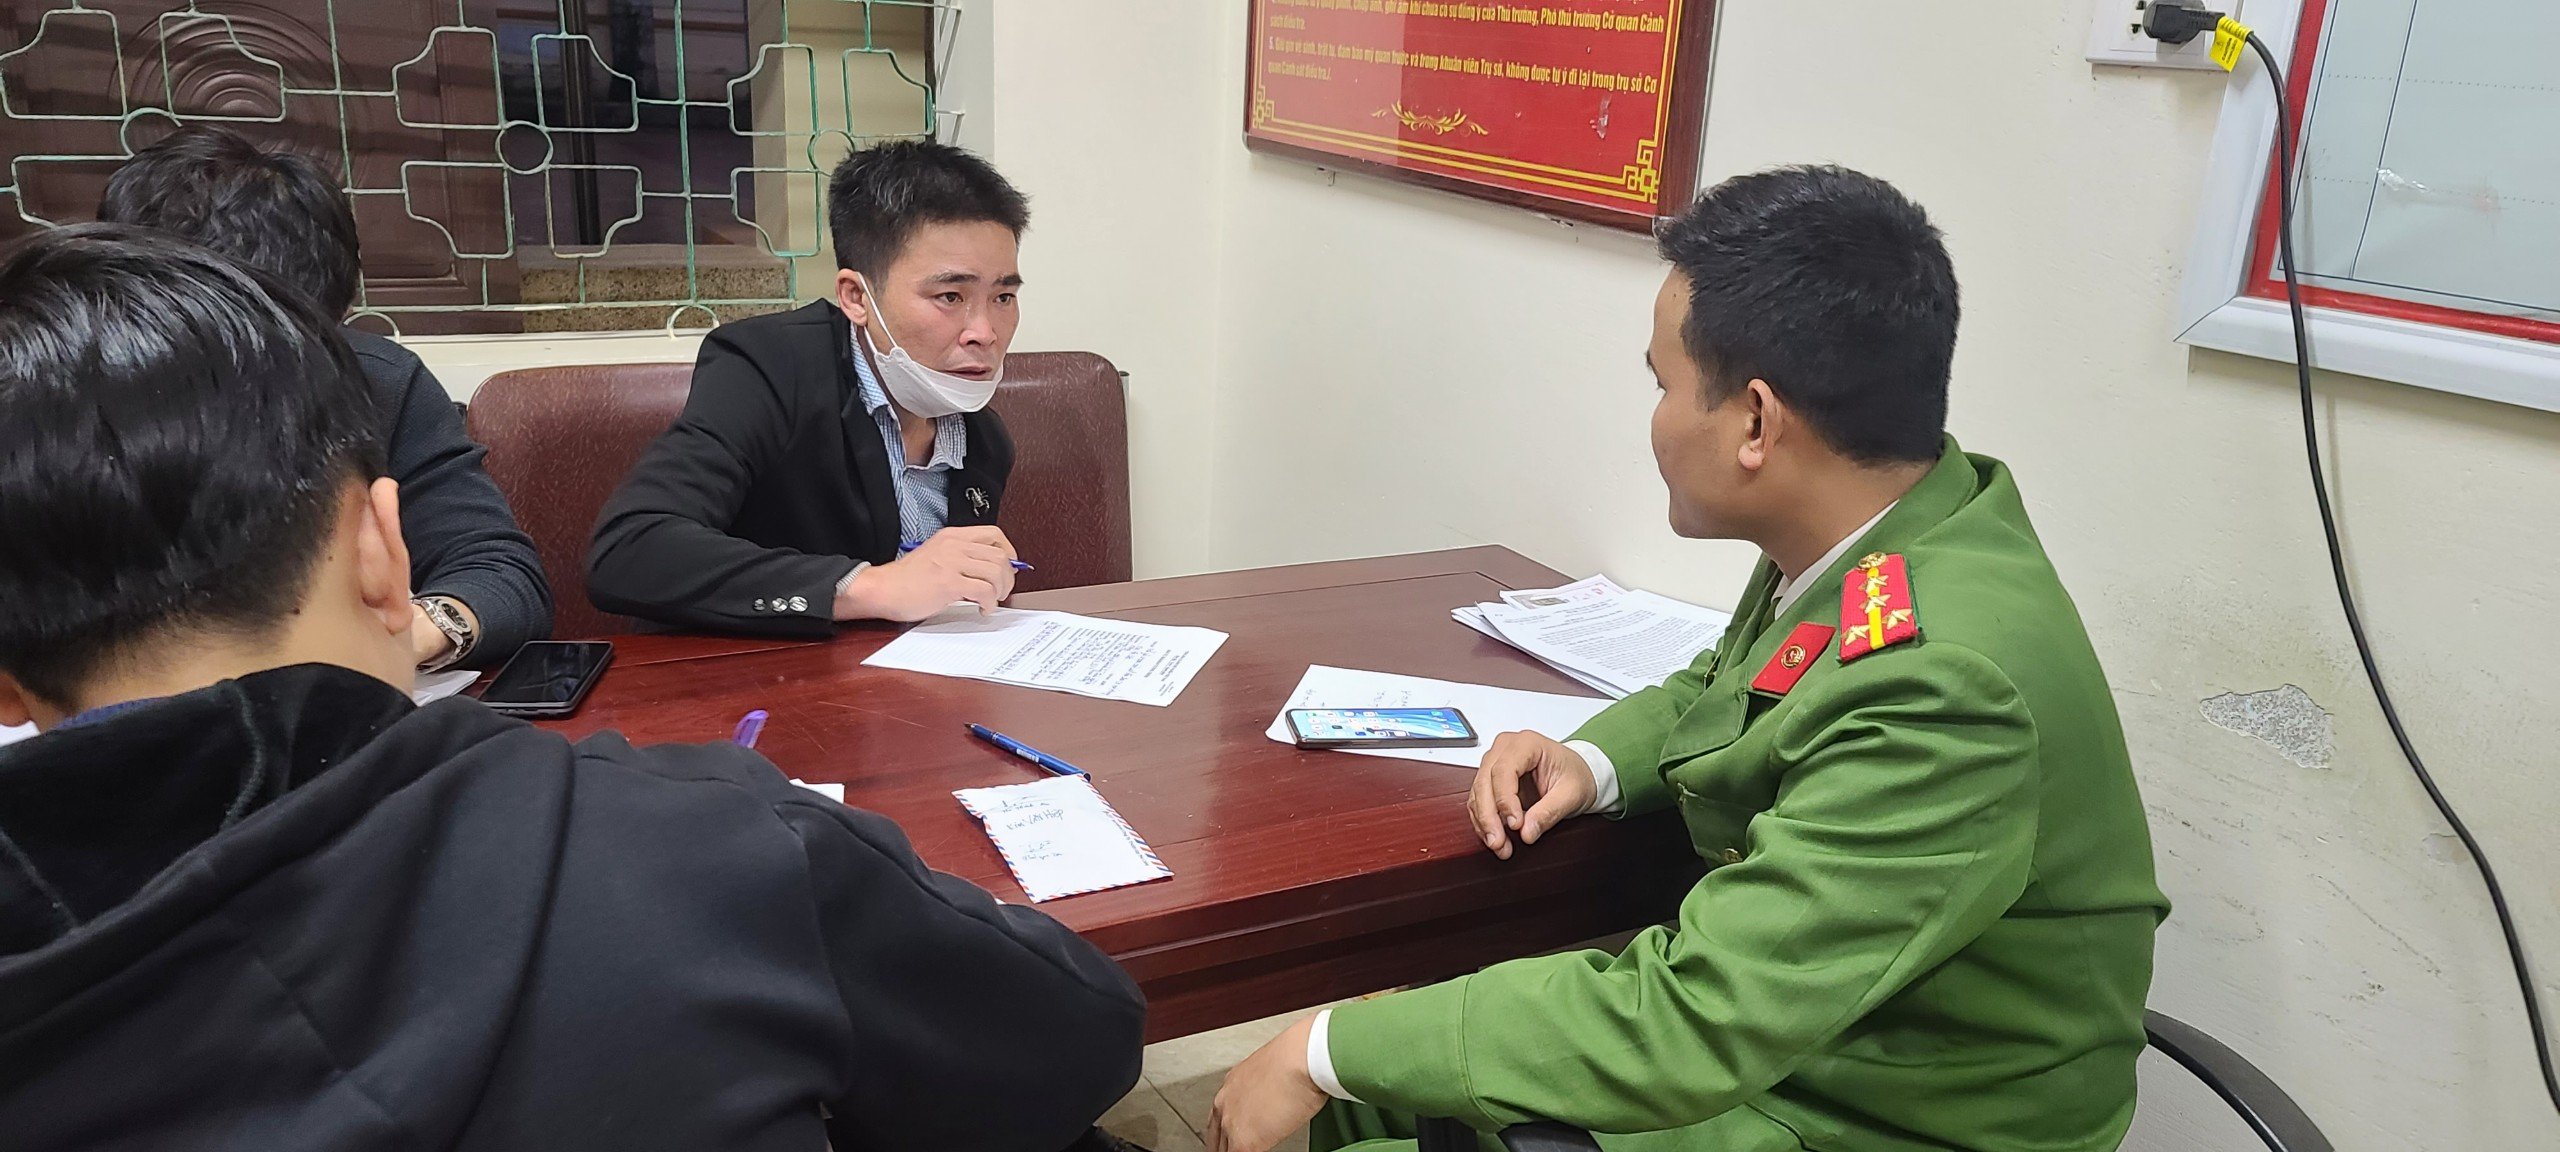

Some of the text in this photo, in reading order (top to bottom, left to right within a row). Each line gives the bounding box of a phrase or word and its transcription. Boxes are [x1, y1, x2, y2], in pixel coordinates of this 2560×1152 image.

[1497, 4, 1511, 22] Thủ
[1572, 8, 1601, 31] trưởng
[1615, 14, 1639, 32] quan
[1639, 11, 1664, 33] Cảnh
[1419, 53, 1439, 71] trong
[1463, 57, 1479, 74] viên
[1480, 58, 1492, 79] Trụ
[1506, 61, 1530, 82] không
[1531, 64, 1551, 86] được
[1552, 66, 1561, 87] tự
[1568, 68, 1577, 85] đi
[1579, 69, 1590, 90] lại
[1592, 70, 1615, 91] trong
[1616, 73, 1629, 95] trụ
[1630, 72, 1643, 93] sở
